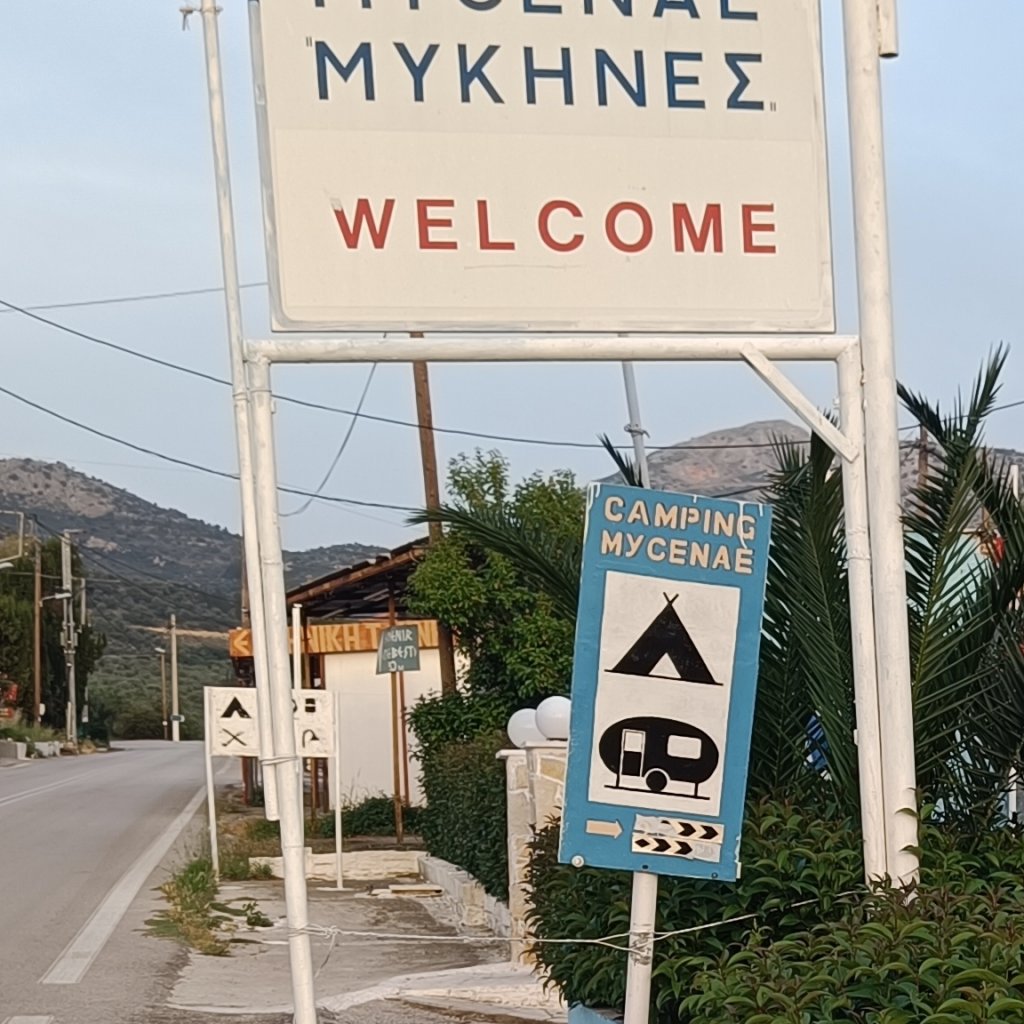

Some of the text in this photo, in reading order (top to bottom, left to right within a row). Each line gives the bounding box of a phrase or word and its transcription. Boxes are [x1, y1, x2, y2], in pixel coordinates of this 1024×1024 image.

[333, 197, 777, 254] WELCOME
[604, 496, 756, 540] CAMPING
[601, 529, 754, 575] MYCENAE
